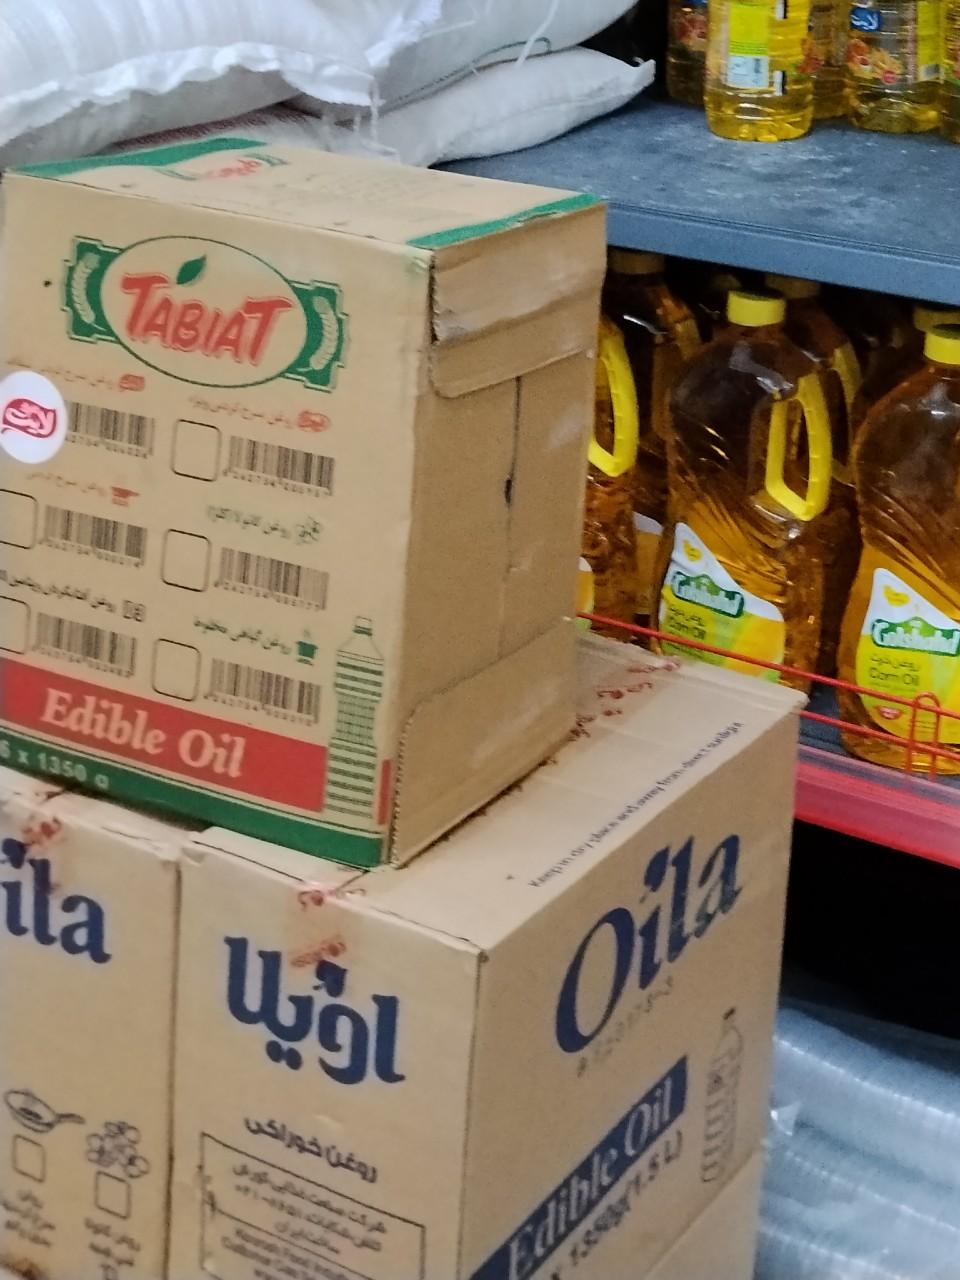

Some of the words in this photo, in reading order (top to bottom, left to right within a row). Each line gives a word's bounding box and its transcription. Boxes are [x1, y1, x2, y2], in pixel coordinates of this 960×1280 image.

[121, 272, 294, 368] TABIAT
[869, 667, 899, 681] Corn
[903, 673, 920, 686] Oil
[37, 752, 89, 783] 1350
[39, 687, 168, 755] Edible
[178, 729, 247, 779] Oil
[0, 838, 112, 964] ila
[556, 834, 744, 1055] Oila
[243, 1118, 323, 1158] خوراکی
[326, 1144, 378, 1183] روغن
[506, 1146, 619, 1280] Edible
[623, 1076, 673, 1158] Oil
